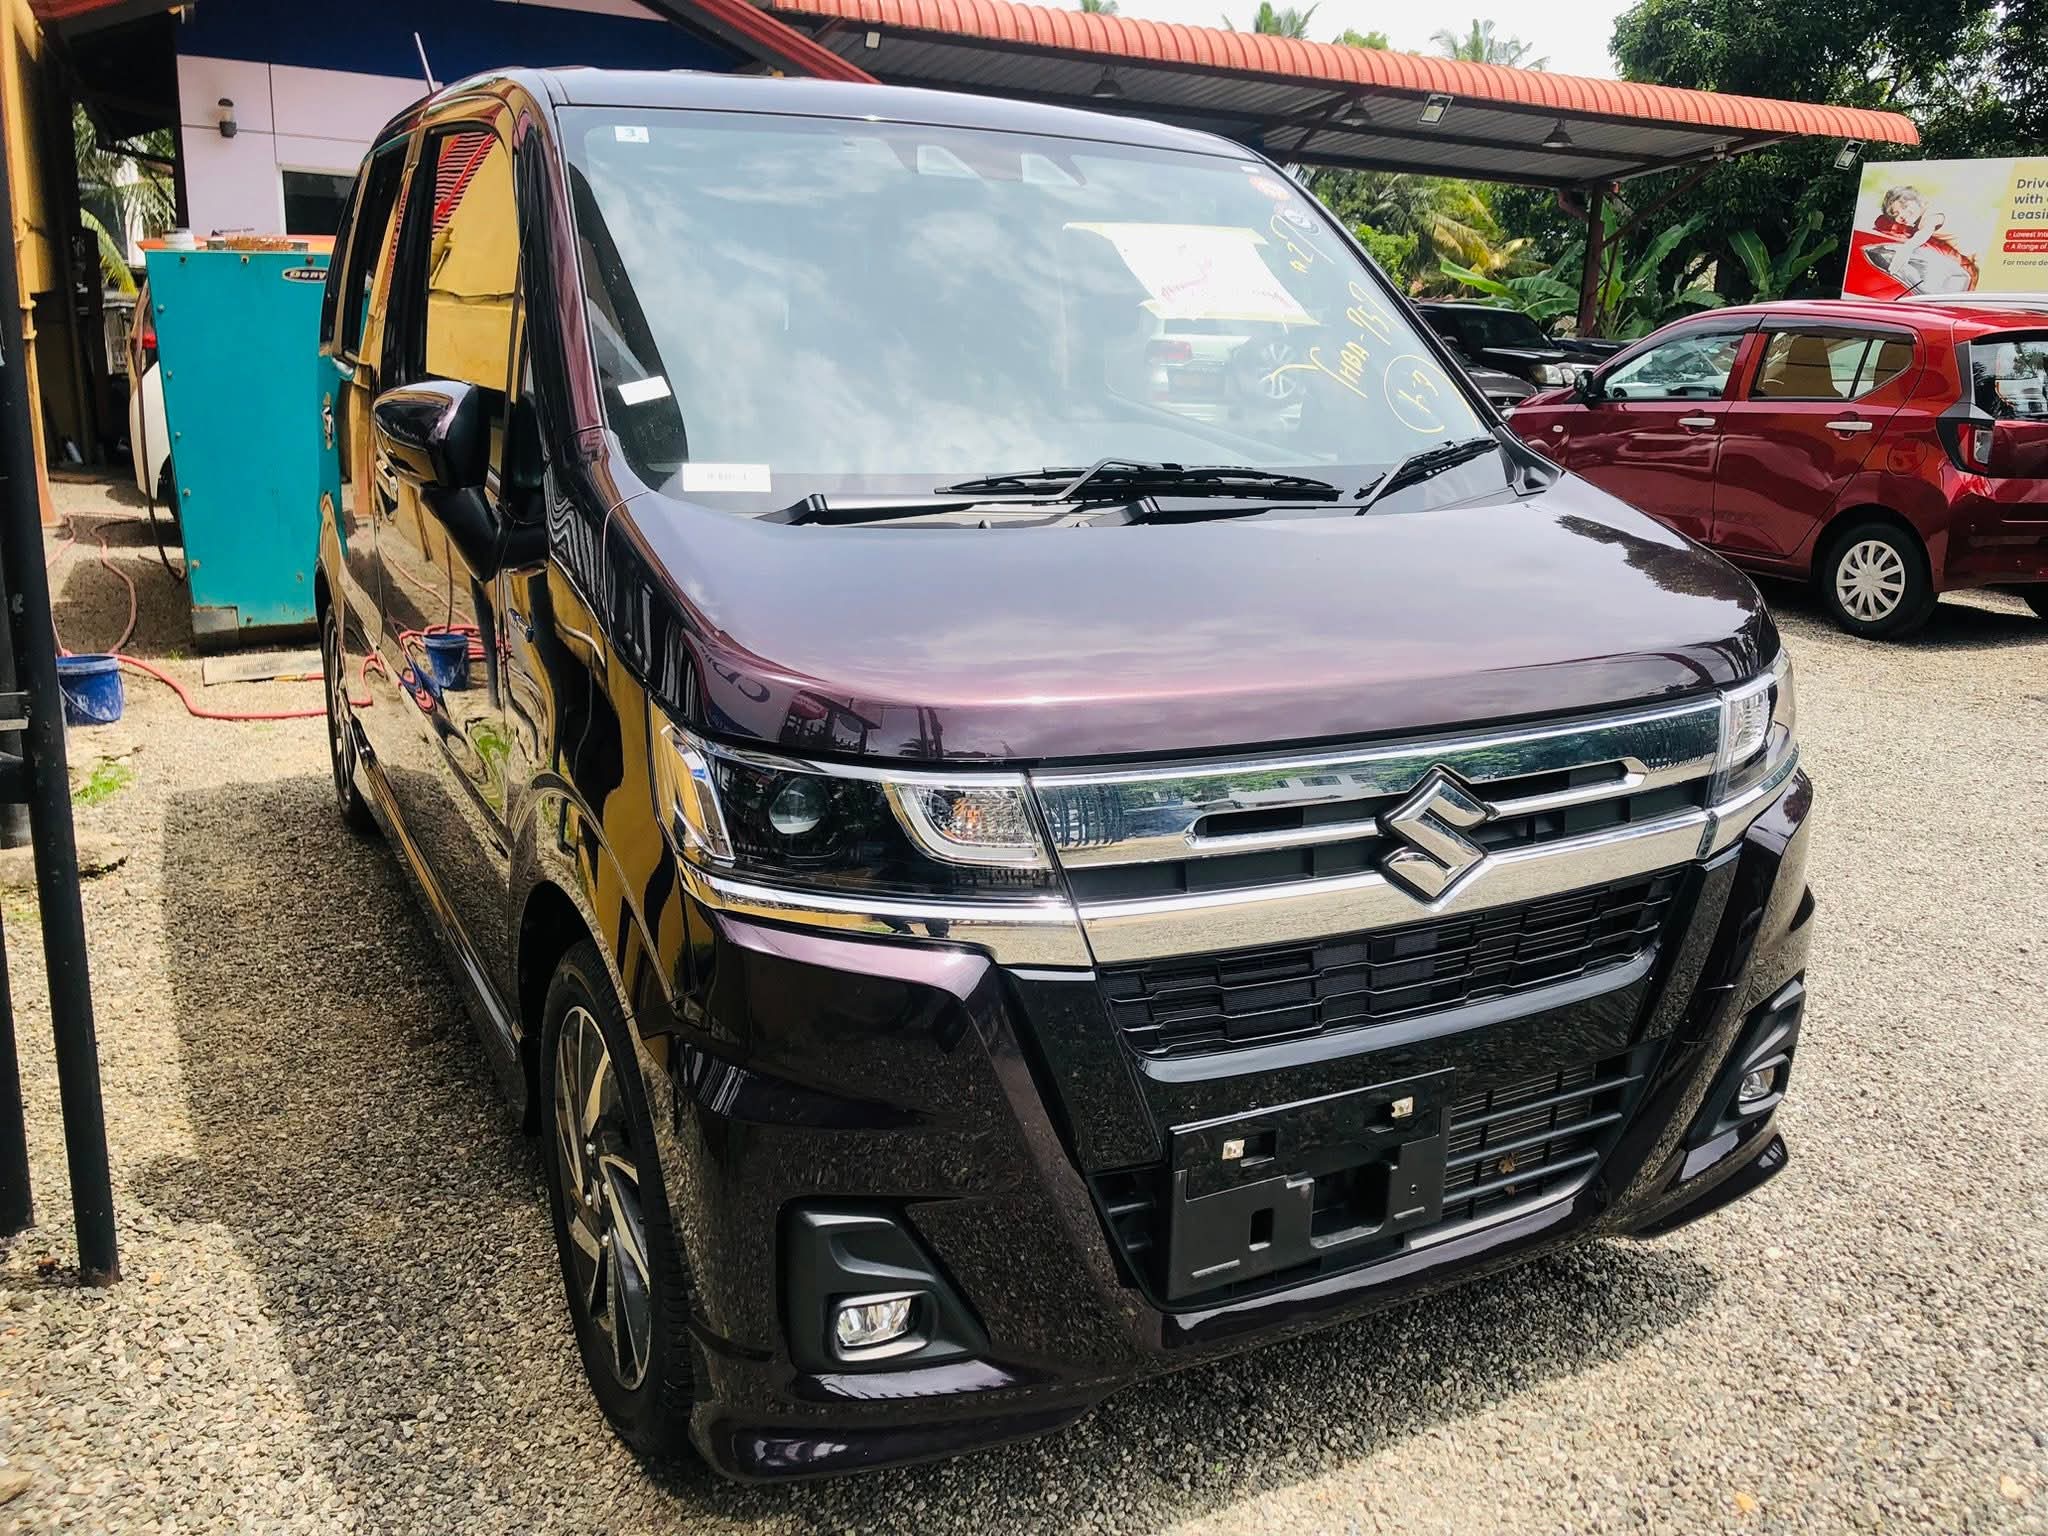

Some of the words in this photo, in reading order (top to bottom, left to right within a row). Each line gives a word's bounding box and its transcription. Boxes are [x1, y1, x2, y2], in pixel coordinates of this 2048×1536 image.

[2014, 193, 2043, 204] with
[2017, 243, 2039, 252] Range
[289, 270, 327, 279] Deny
